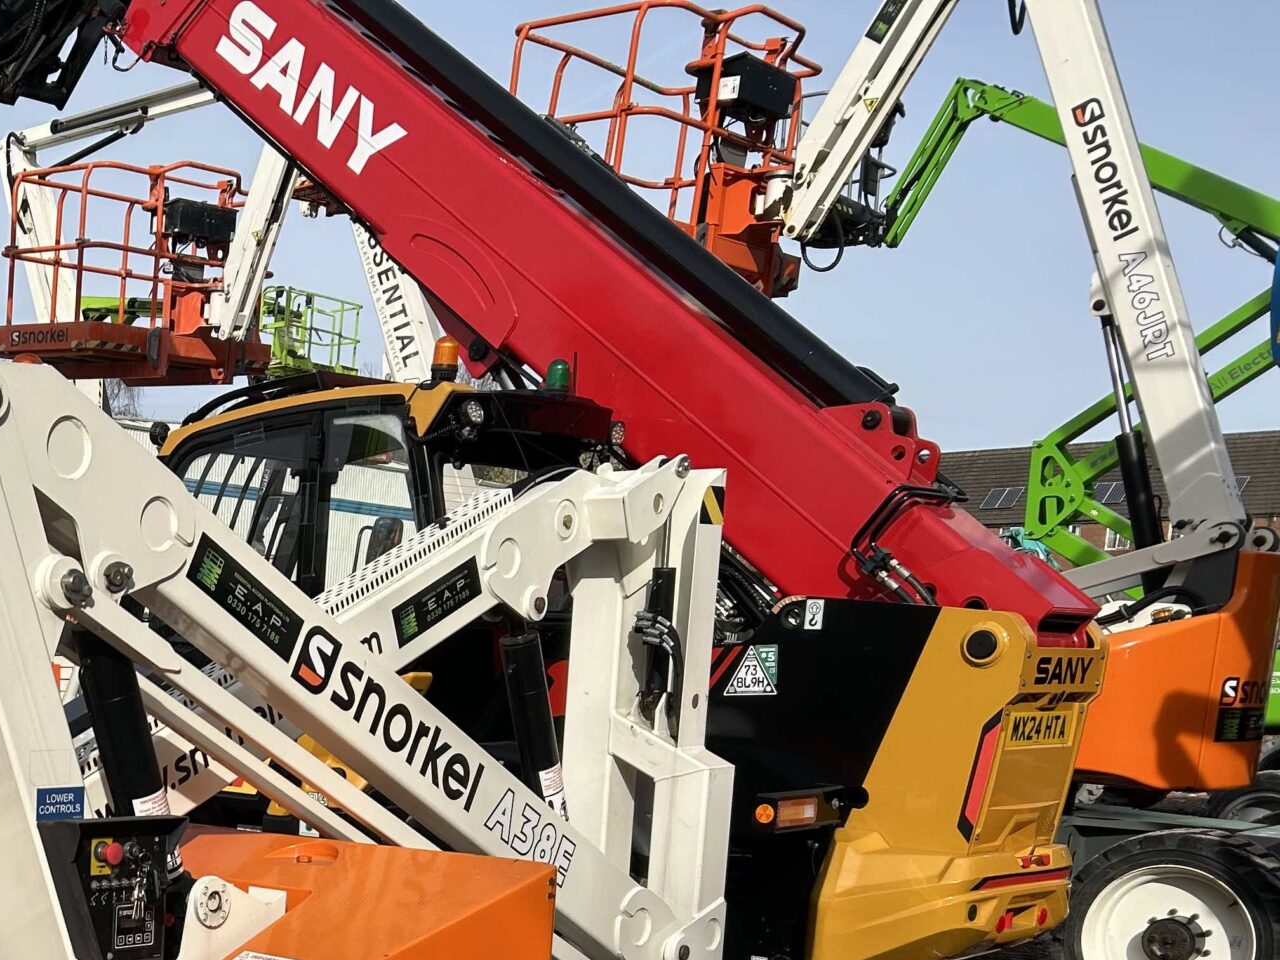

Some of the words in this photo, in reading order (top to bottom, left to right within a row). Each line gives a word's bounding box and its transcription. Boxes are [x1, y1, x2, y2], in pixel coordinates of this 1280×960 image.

[215, 1, 408, 175] SANY
[1118, 251, 1175, 362] A46JRT
[227, 595, 246, 615] 0330
[247, 612, 261, 628] 175
[261, 624, 280, 644] 7185
[736, 677, 765, 688] BL9H
[744, 664, 758, 676] 73
[1034, 656, 1094, 685] SANY
[330, 661, 485, 812] snorkel
[1010, 714, 1042, 741] MX24
[1042, 714, 1066, 739] HTA
[38, 804, 81, 815] CONTROLS
[46, 793, 75, 803] LOWER
